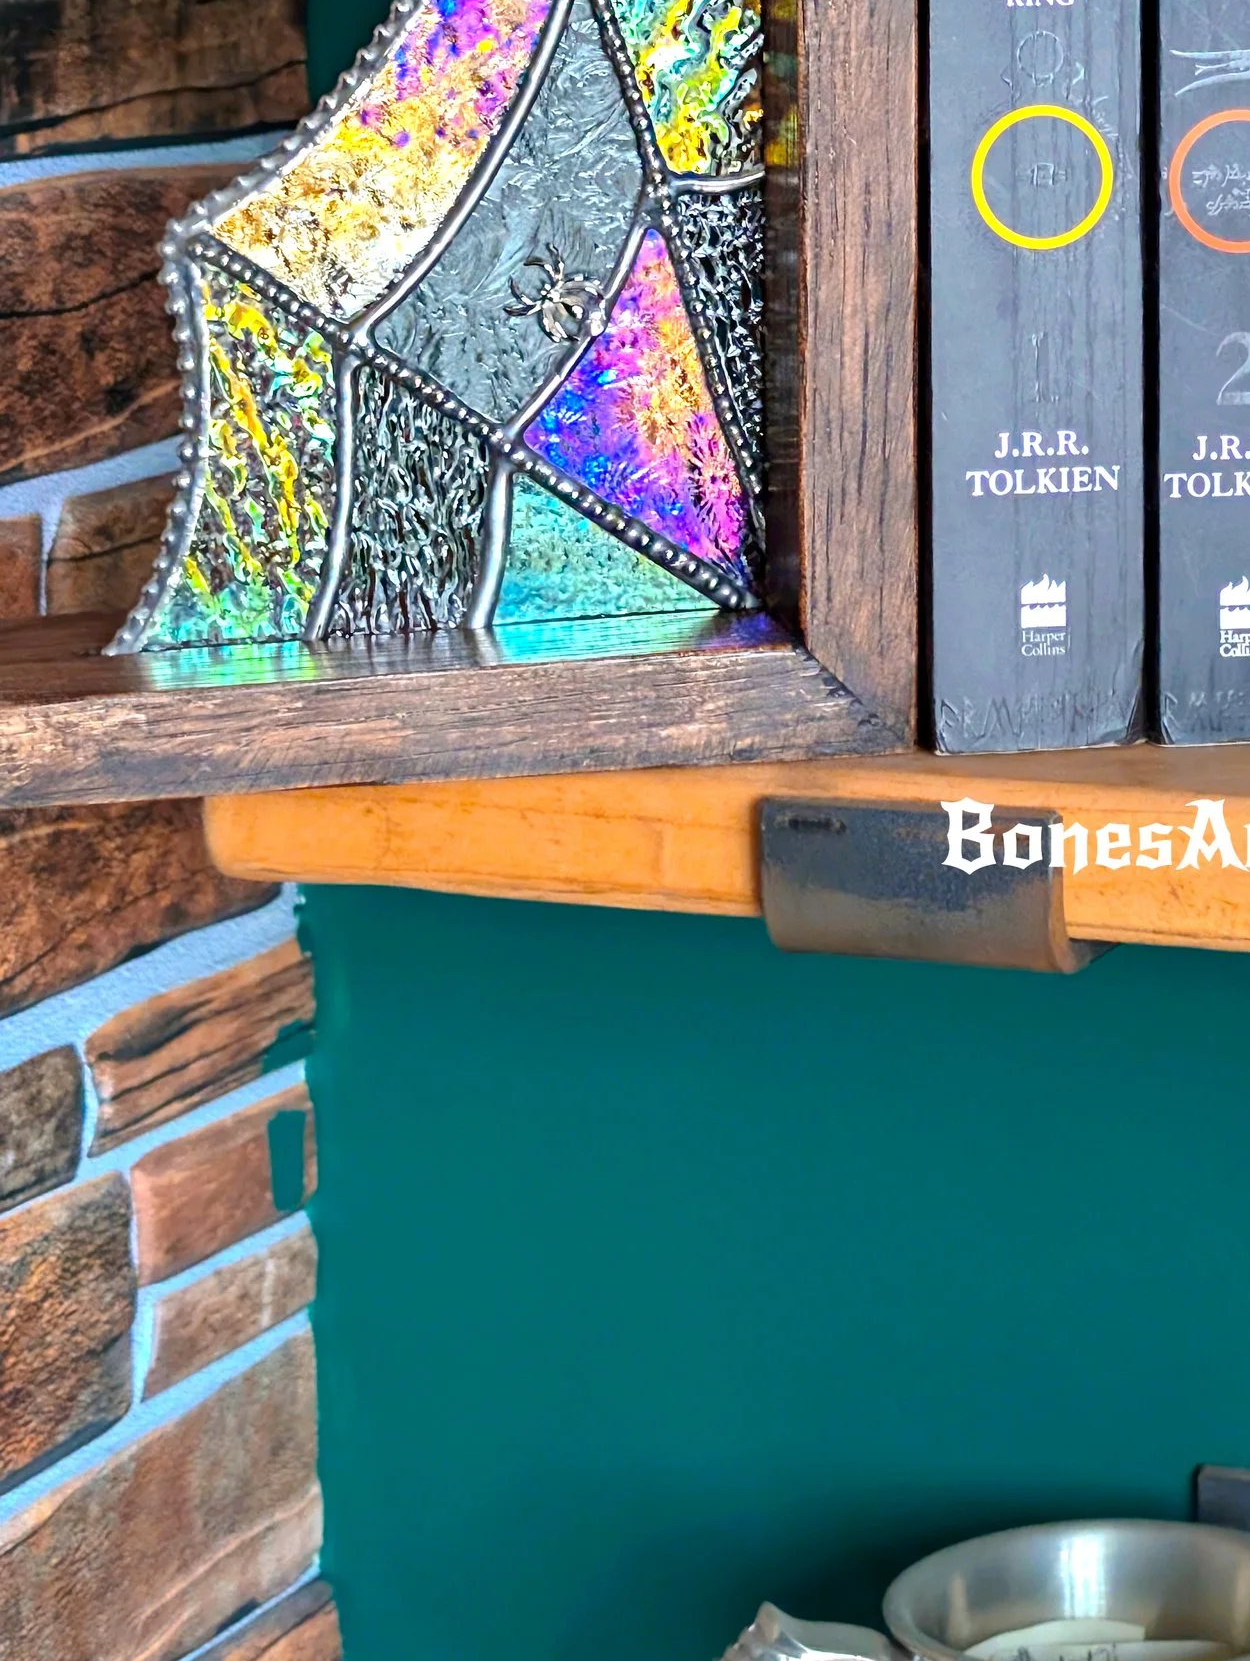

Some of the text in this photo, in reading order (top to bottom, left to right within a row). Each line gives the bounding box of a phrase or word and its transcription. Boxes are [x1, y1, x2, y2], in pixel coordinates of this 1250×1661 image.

[994, 430, 1089, 459] J.R.R.
[965, 464, 1121, 497] TOLKIEN
[1021, 630, 1066, 644] Harper
[1020, 643, 1066, 657] Collins
